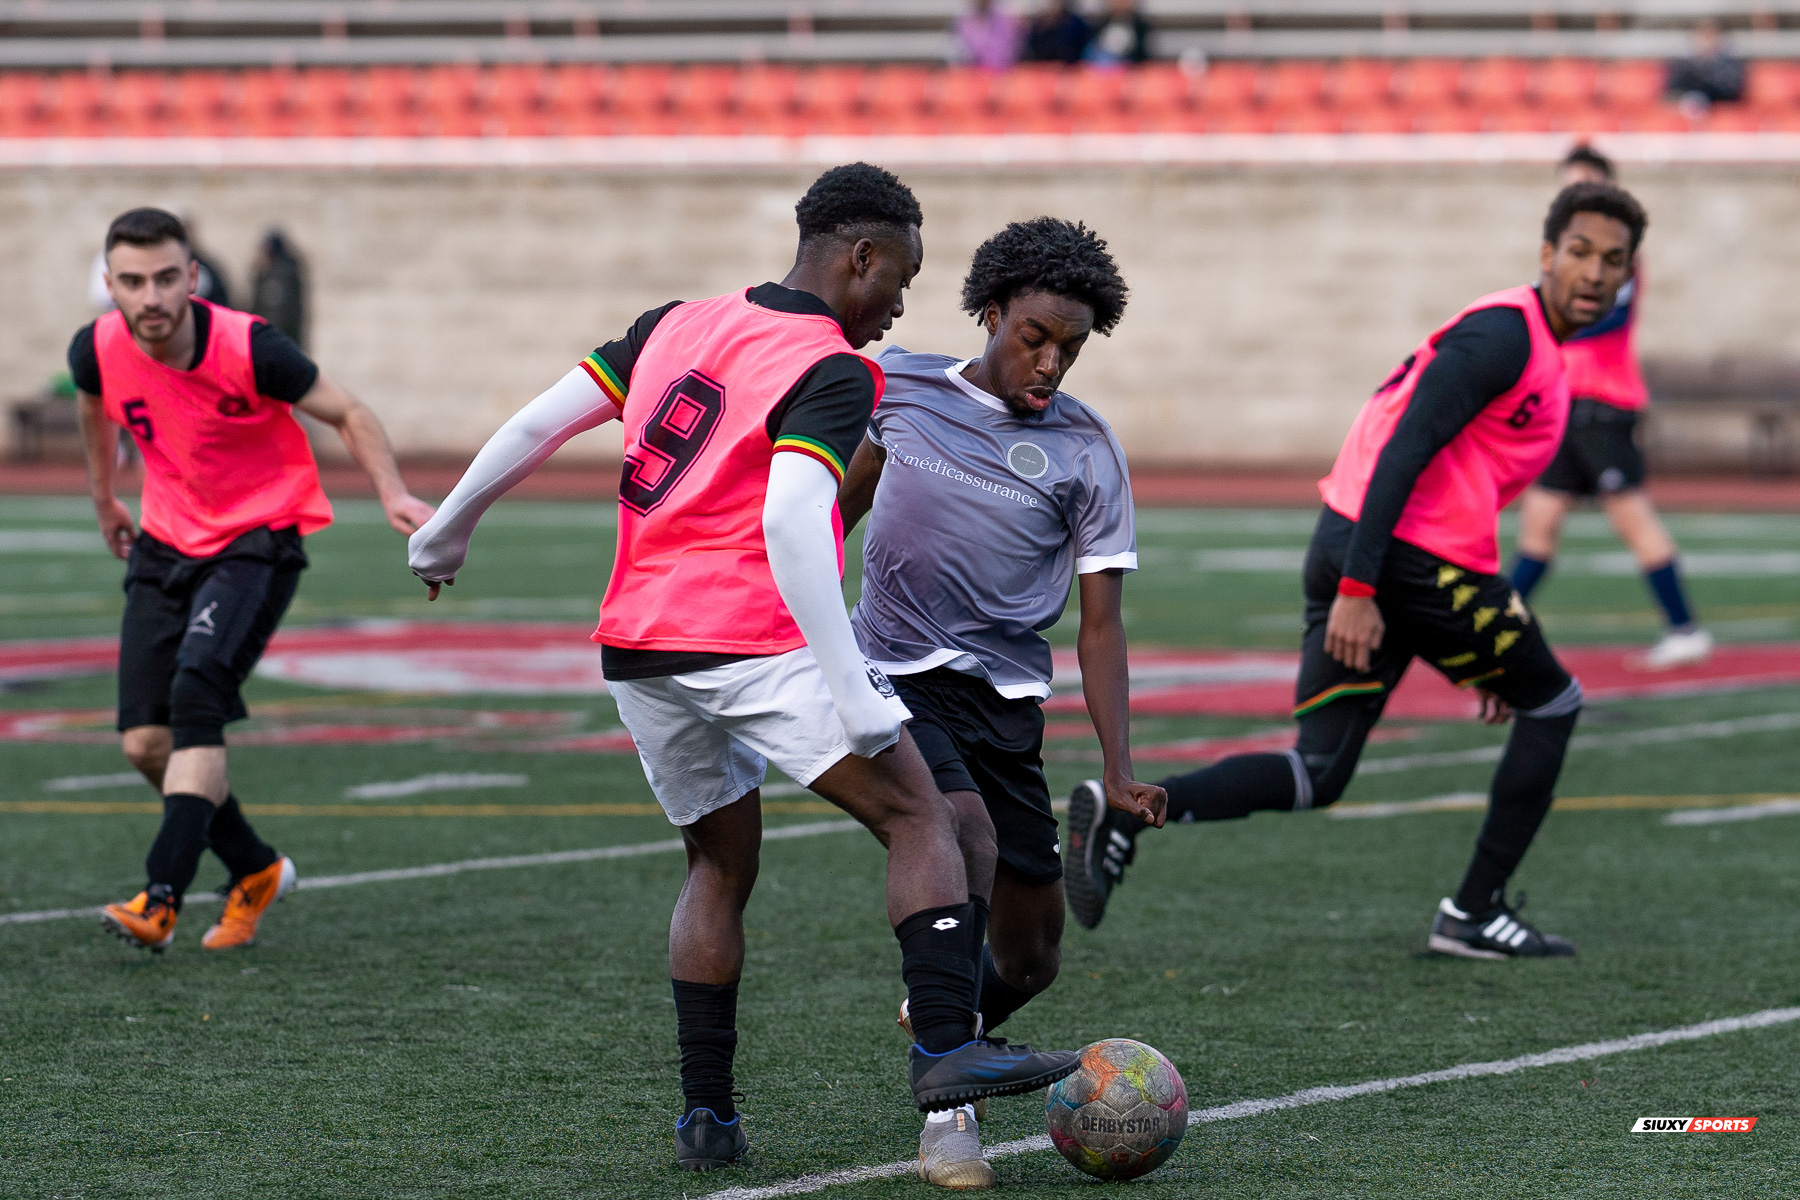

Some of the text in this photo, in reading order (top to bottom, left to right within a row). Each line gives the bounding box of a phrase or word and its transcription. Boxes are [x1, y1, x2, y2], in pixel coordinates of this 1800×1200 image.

[122, 398, 154, 442] 5
[1507, 392, 1541, 431] 6
[619, 369, 726, 518] 9
[903, 454, 1038, 509] médicassurance
[1081, 1115, 1160, 1134] DERBYSTAR
